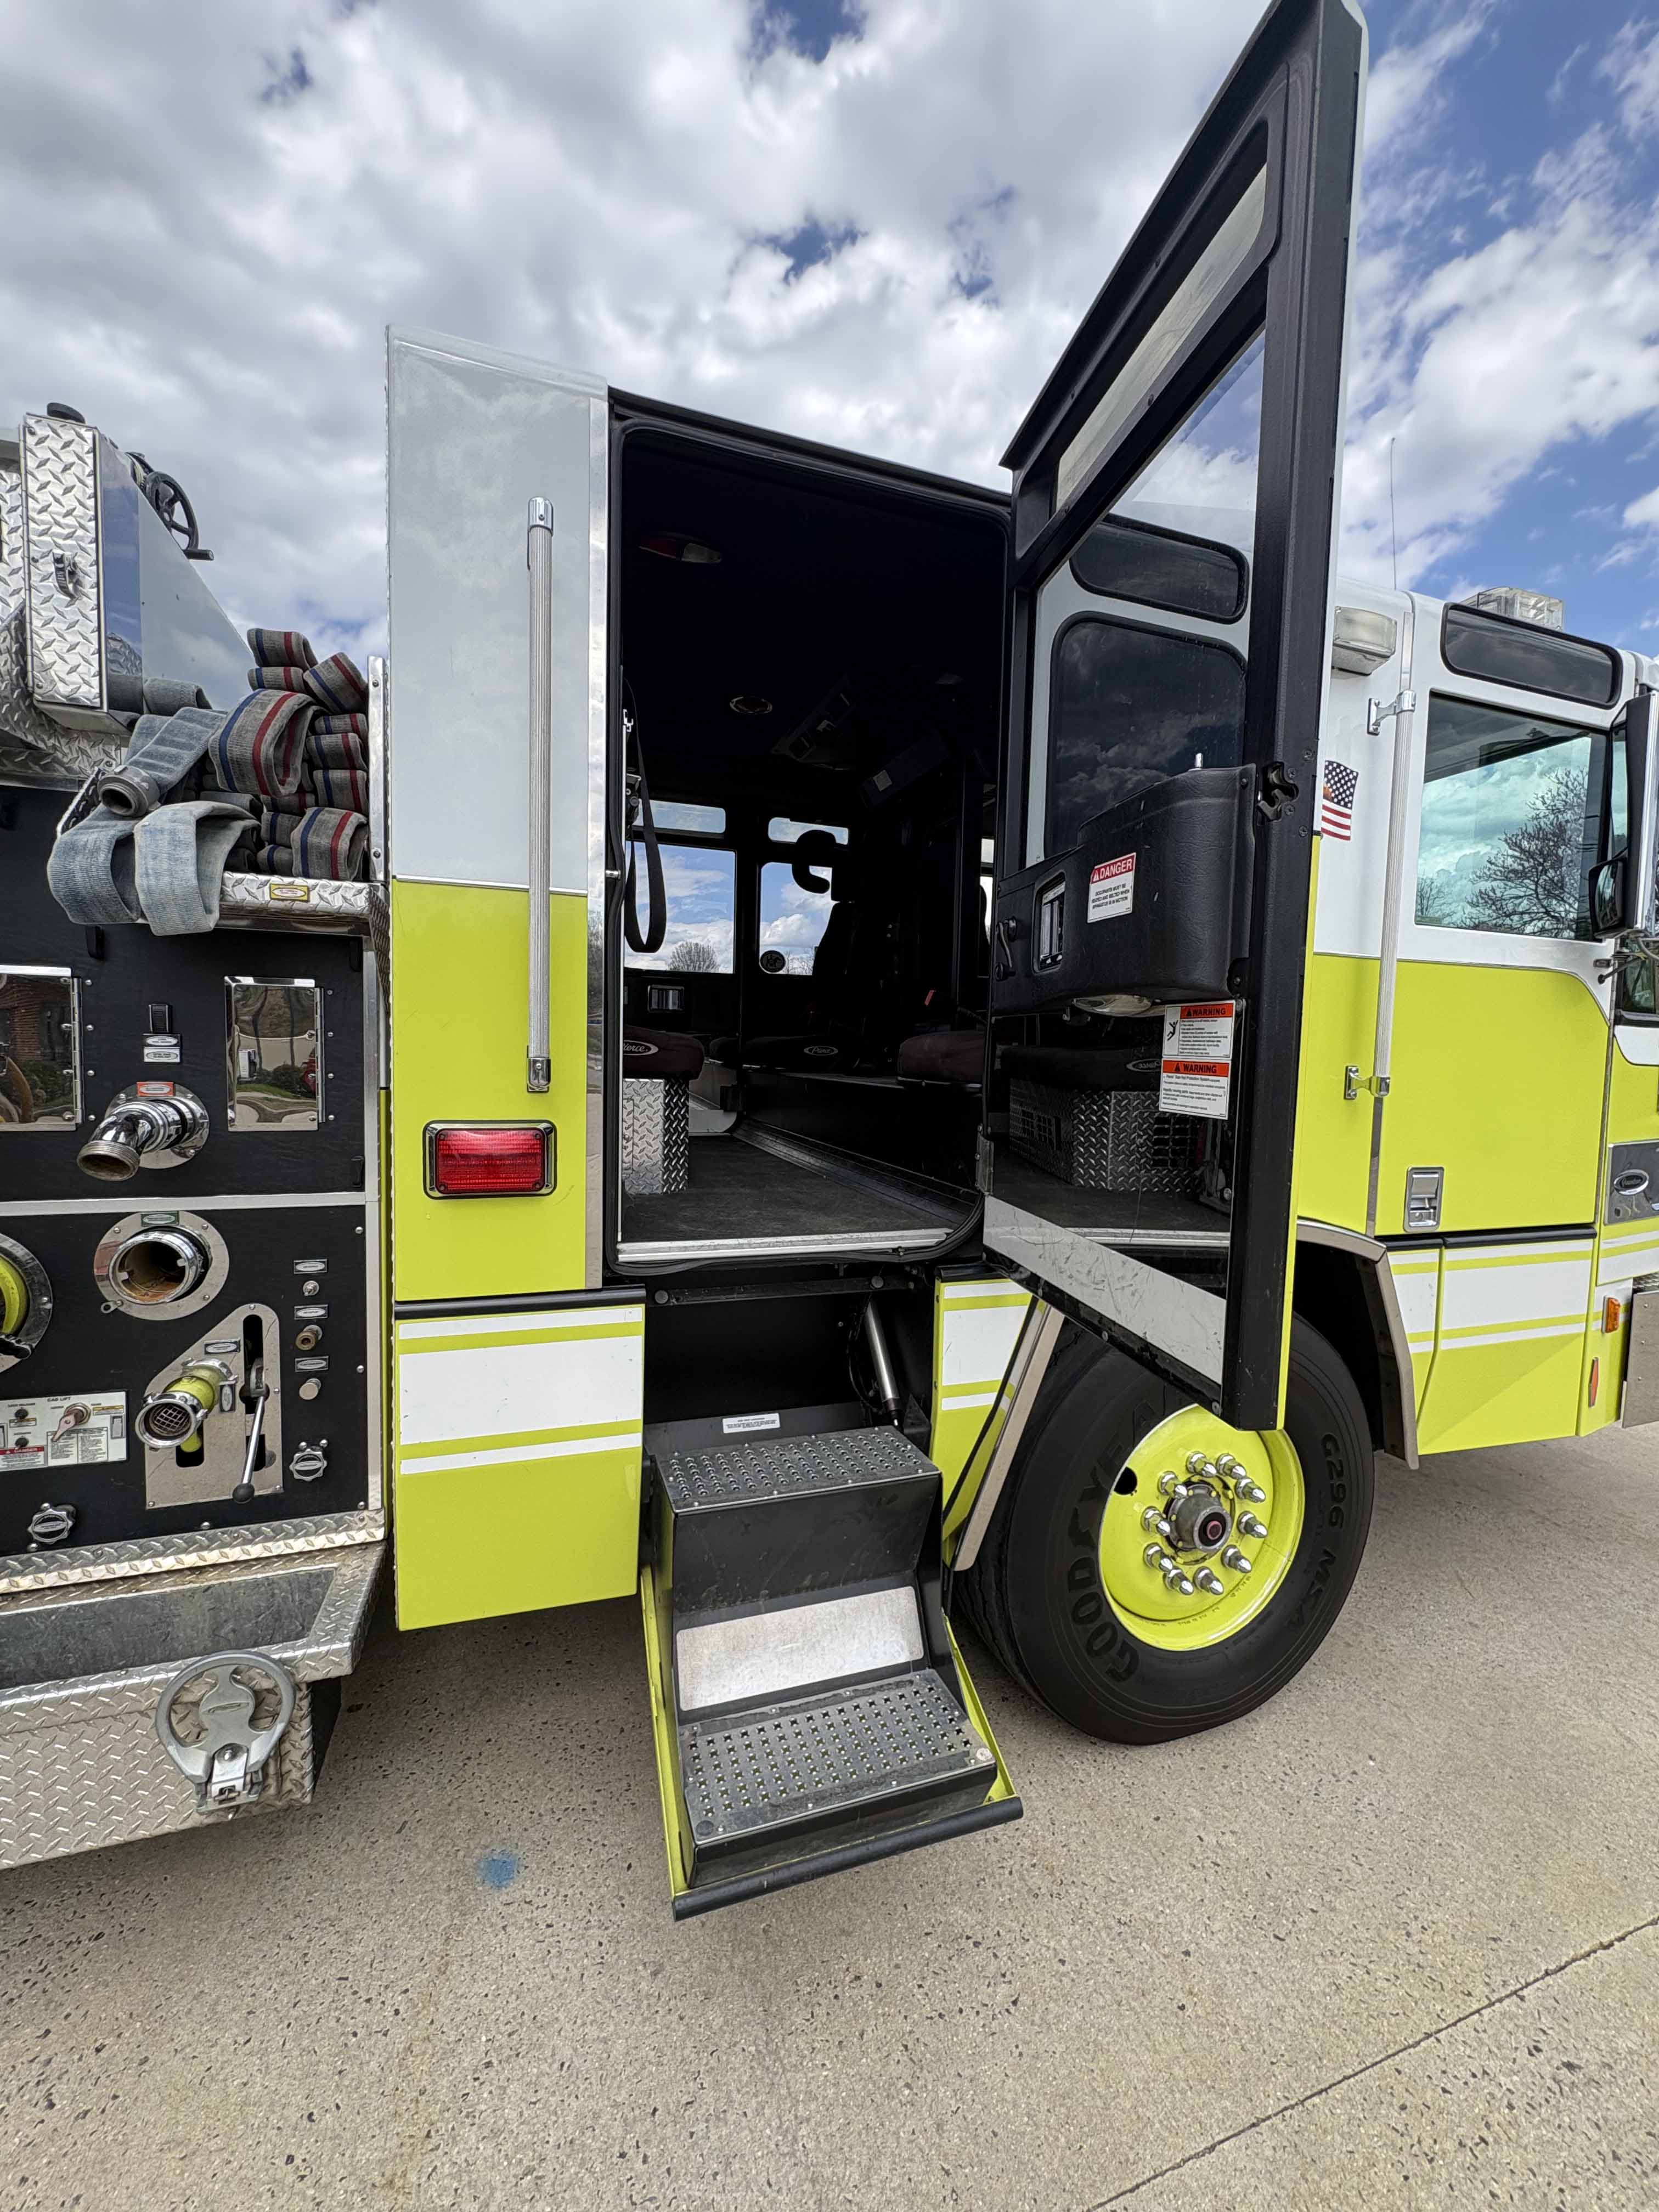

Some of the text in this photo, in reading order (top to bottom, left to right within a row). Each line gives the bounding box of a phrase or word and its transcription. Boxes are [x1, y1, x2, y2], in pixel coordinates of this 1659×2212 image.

[1099, 859, 1132, 879] DANGER
[1183, 1063, 1217, 1074] WARNING
[1322, 1432, 1347, 1530] G296
